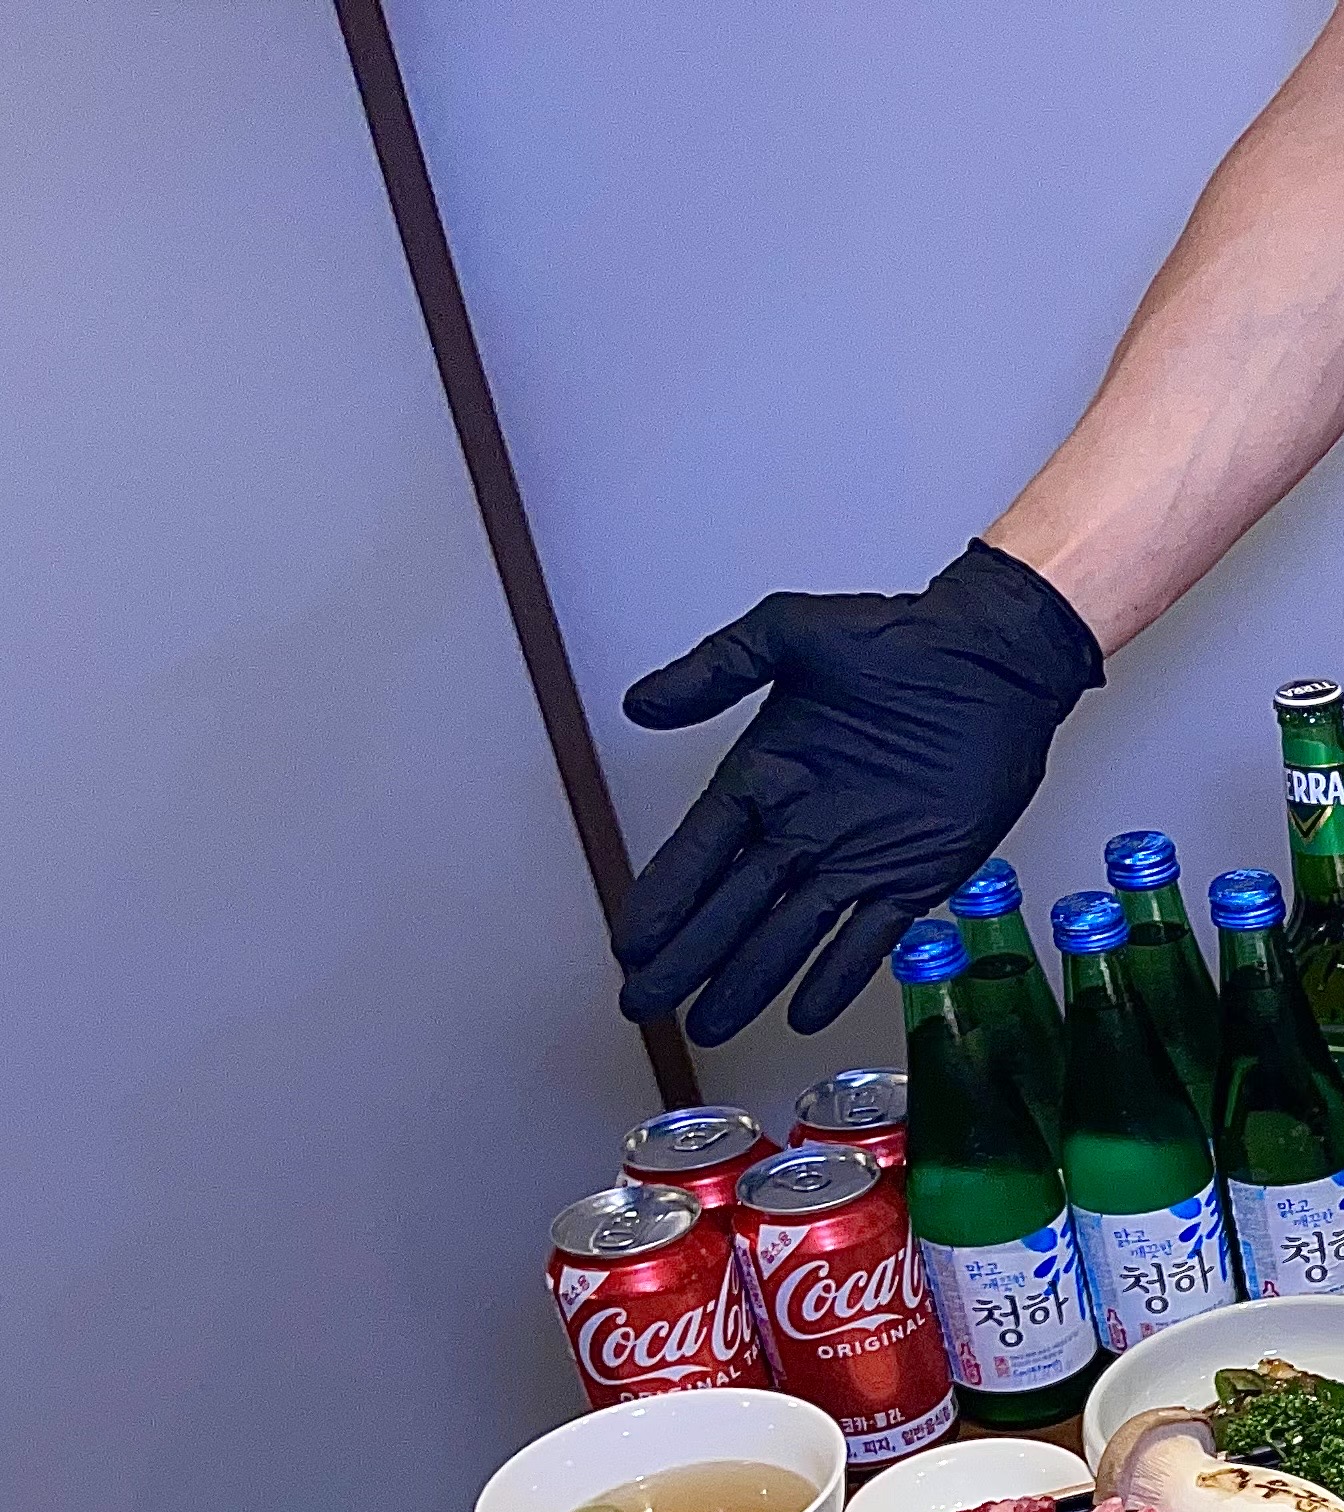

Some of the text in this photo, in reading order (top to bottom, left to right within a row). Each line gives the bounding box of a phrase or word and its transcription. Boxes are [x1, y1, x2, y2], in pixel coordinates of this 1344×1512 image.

[972, 1279, 1070, 1348] 청하
[1119, 1248, 1215, 1315] 청하
[817, 1312, 926, 1359] ORIGINAL
